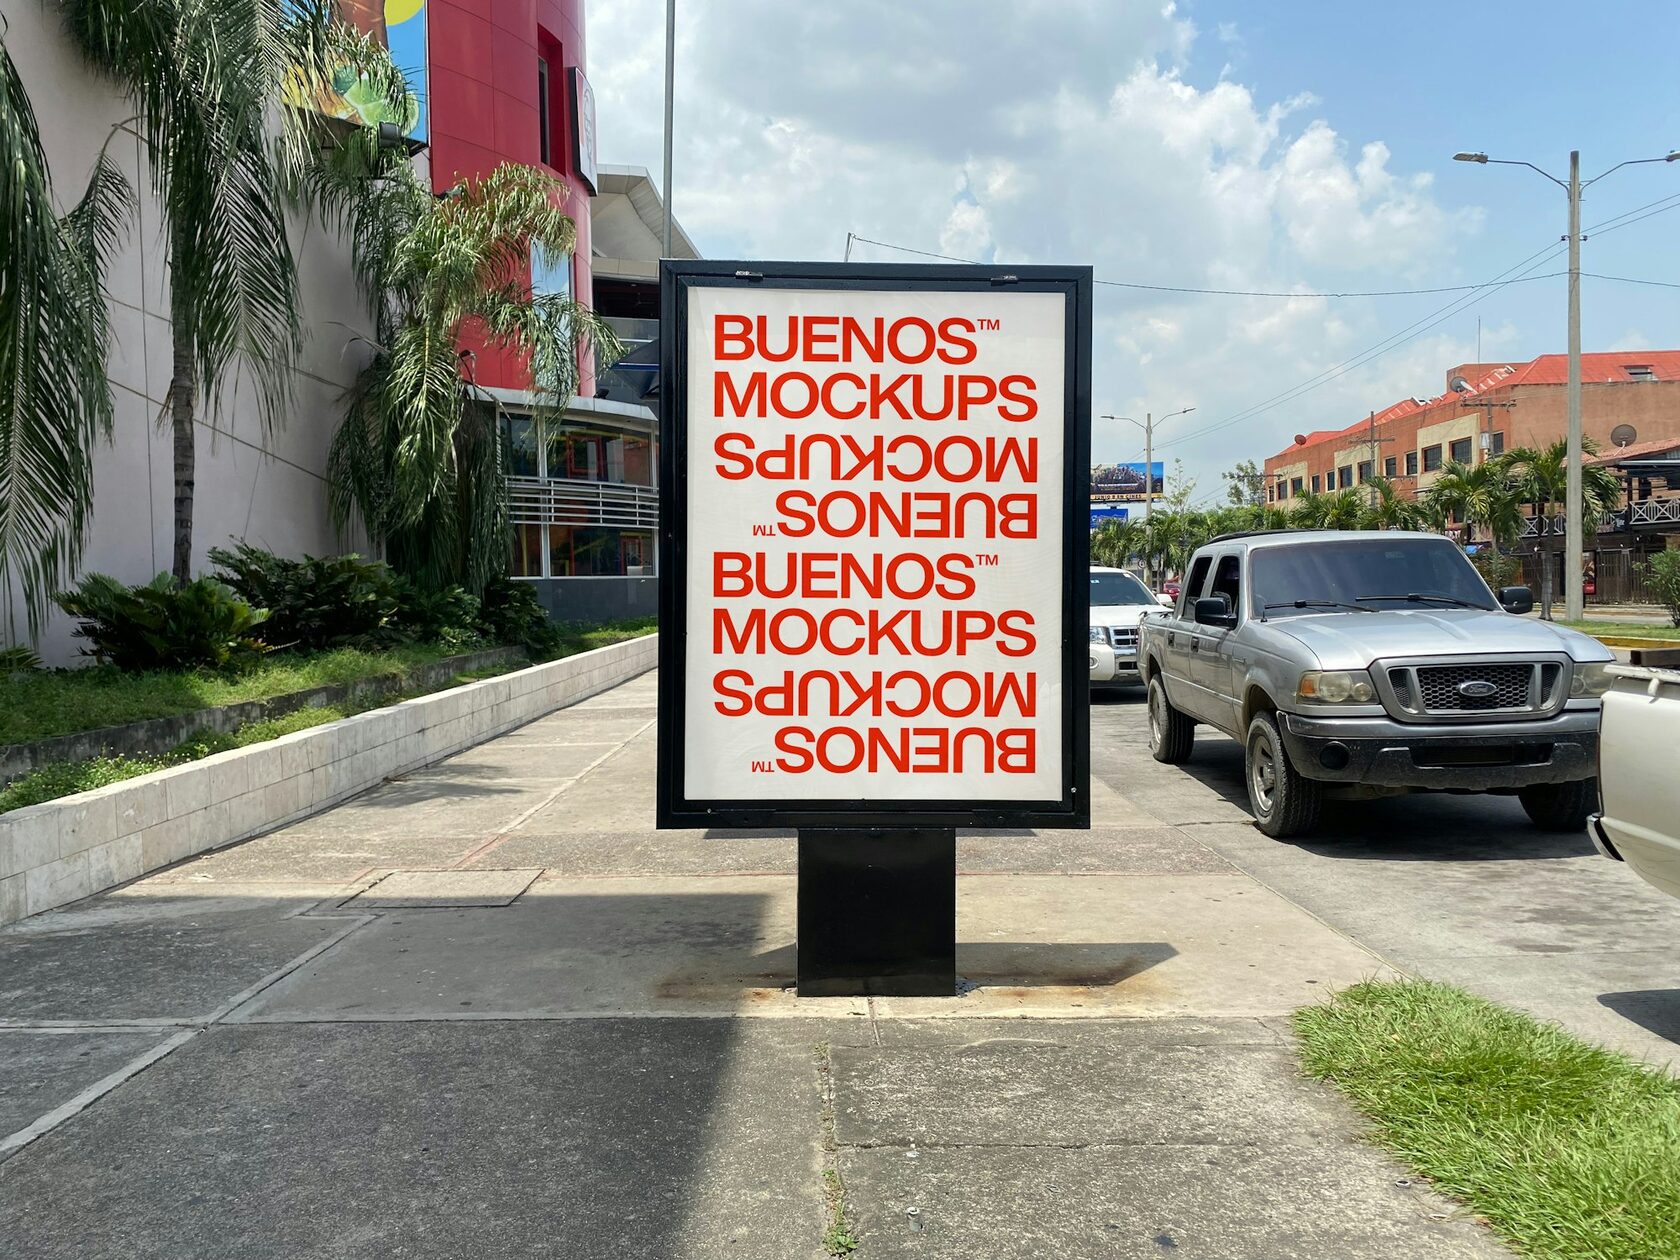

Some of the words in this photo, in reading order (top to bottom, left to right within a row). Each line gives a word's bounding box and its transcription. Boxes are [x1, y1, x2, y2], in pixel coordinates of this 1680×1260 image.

[714, 371, 1038, 422] MOCKUPS
[714, 432, 1038, 483] MOCKUPS
[713, 608, 1036, 657] MOCKUPS
[713, 669, 1036, 718] MOCKUPS
